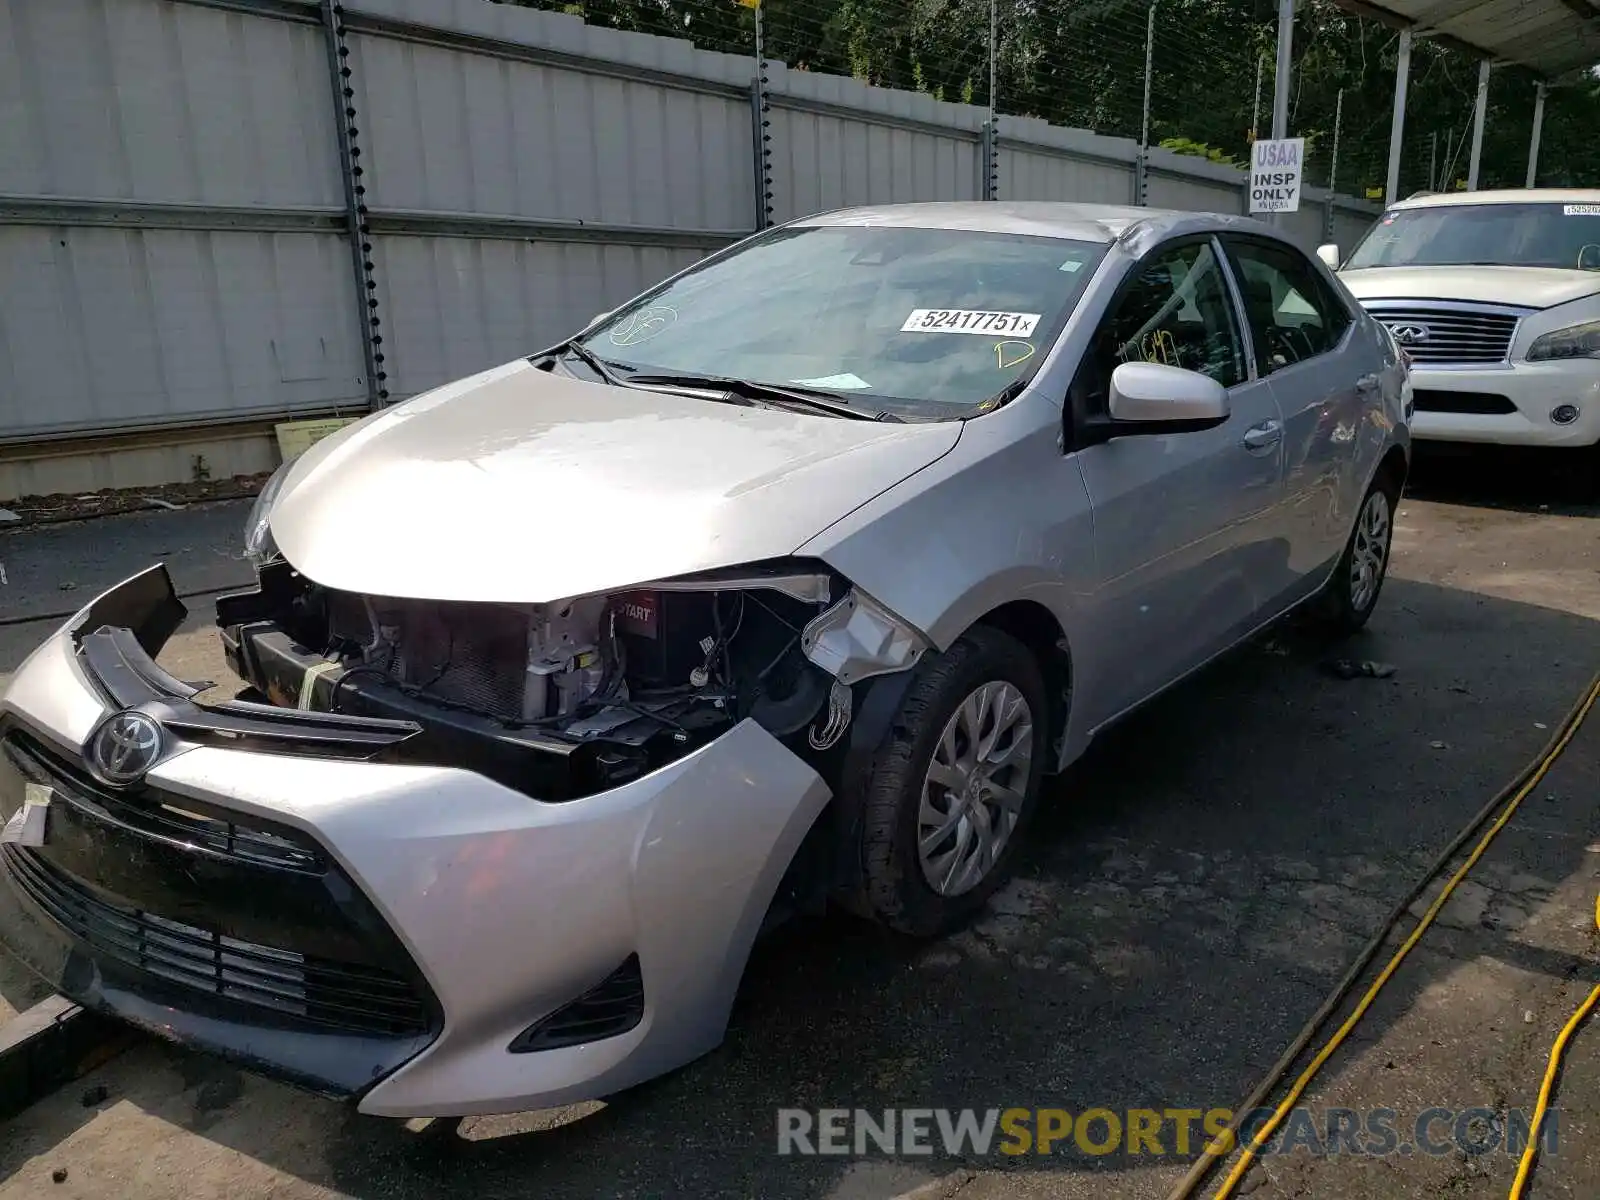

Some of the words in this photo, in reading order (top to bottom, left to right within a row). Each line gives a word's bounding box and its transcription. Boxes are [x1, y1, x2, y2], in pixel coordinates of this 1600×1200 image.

[1257, 144, 1297, 167] USAA
[1255, 173, 1295, 186] INSP
[1252, 188, 1295, 200] ONLY
[921, 311, 1021, 331] 52417751
